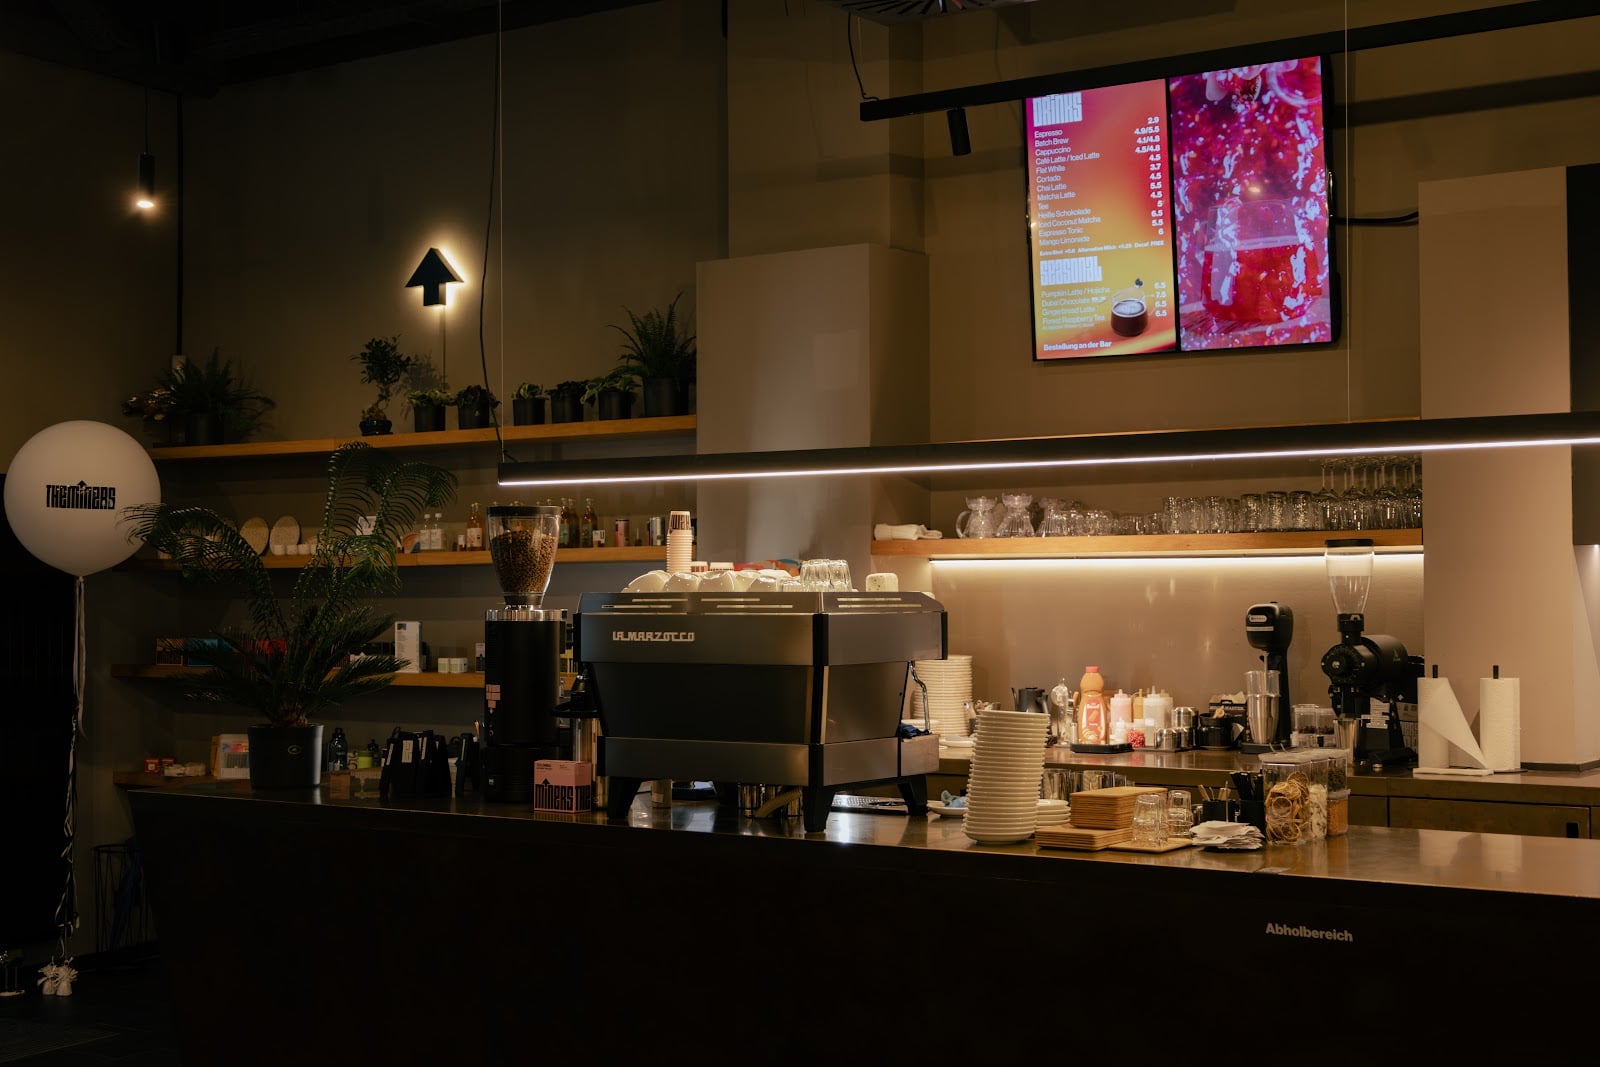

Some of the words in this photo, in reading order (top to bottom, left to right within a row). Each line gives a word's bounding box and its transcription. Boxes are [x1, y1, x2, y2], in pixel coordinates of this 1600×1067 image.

[1034, 130, 1063, 138] Espresso
[1035, 146, 1071, 156] Cappuccino
[1052, 218, 1078, 226] Coconut
[1044, 342, 1078, 351] Bestellung
[627, 631, 695, 642] MARZOCCO
[1265, 922, 1354, 942] Abholbereich
